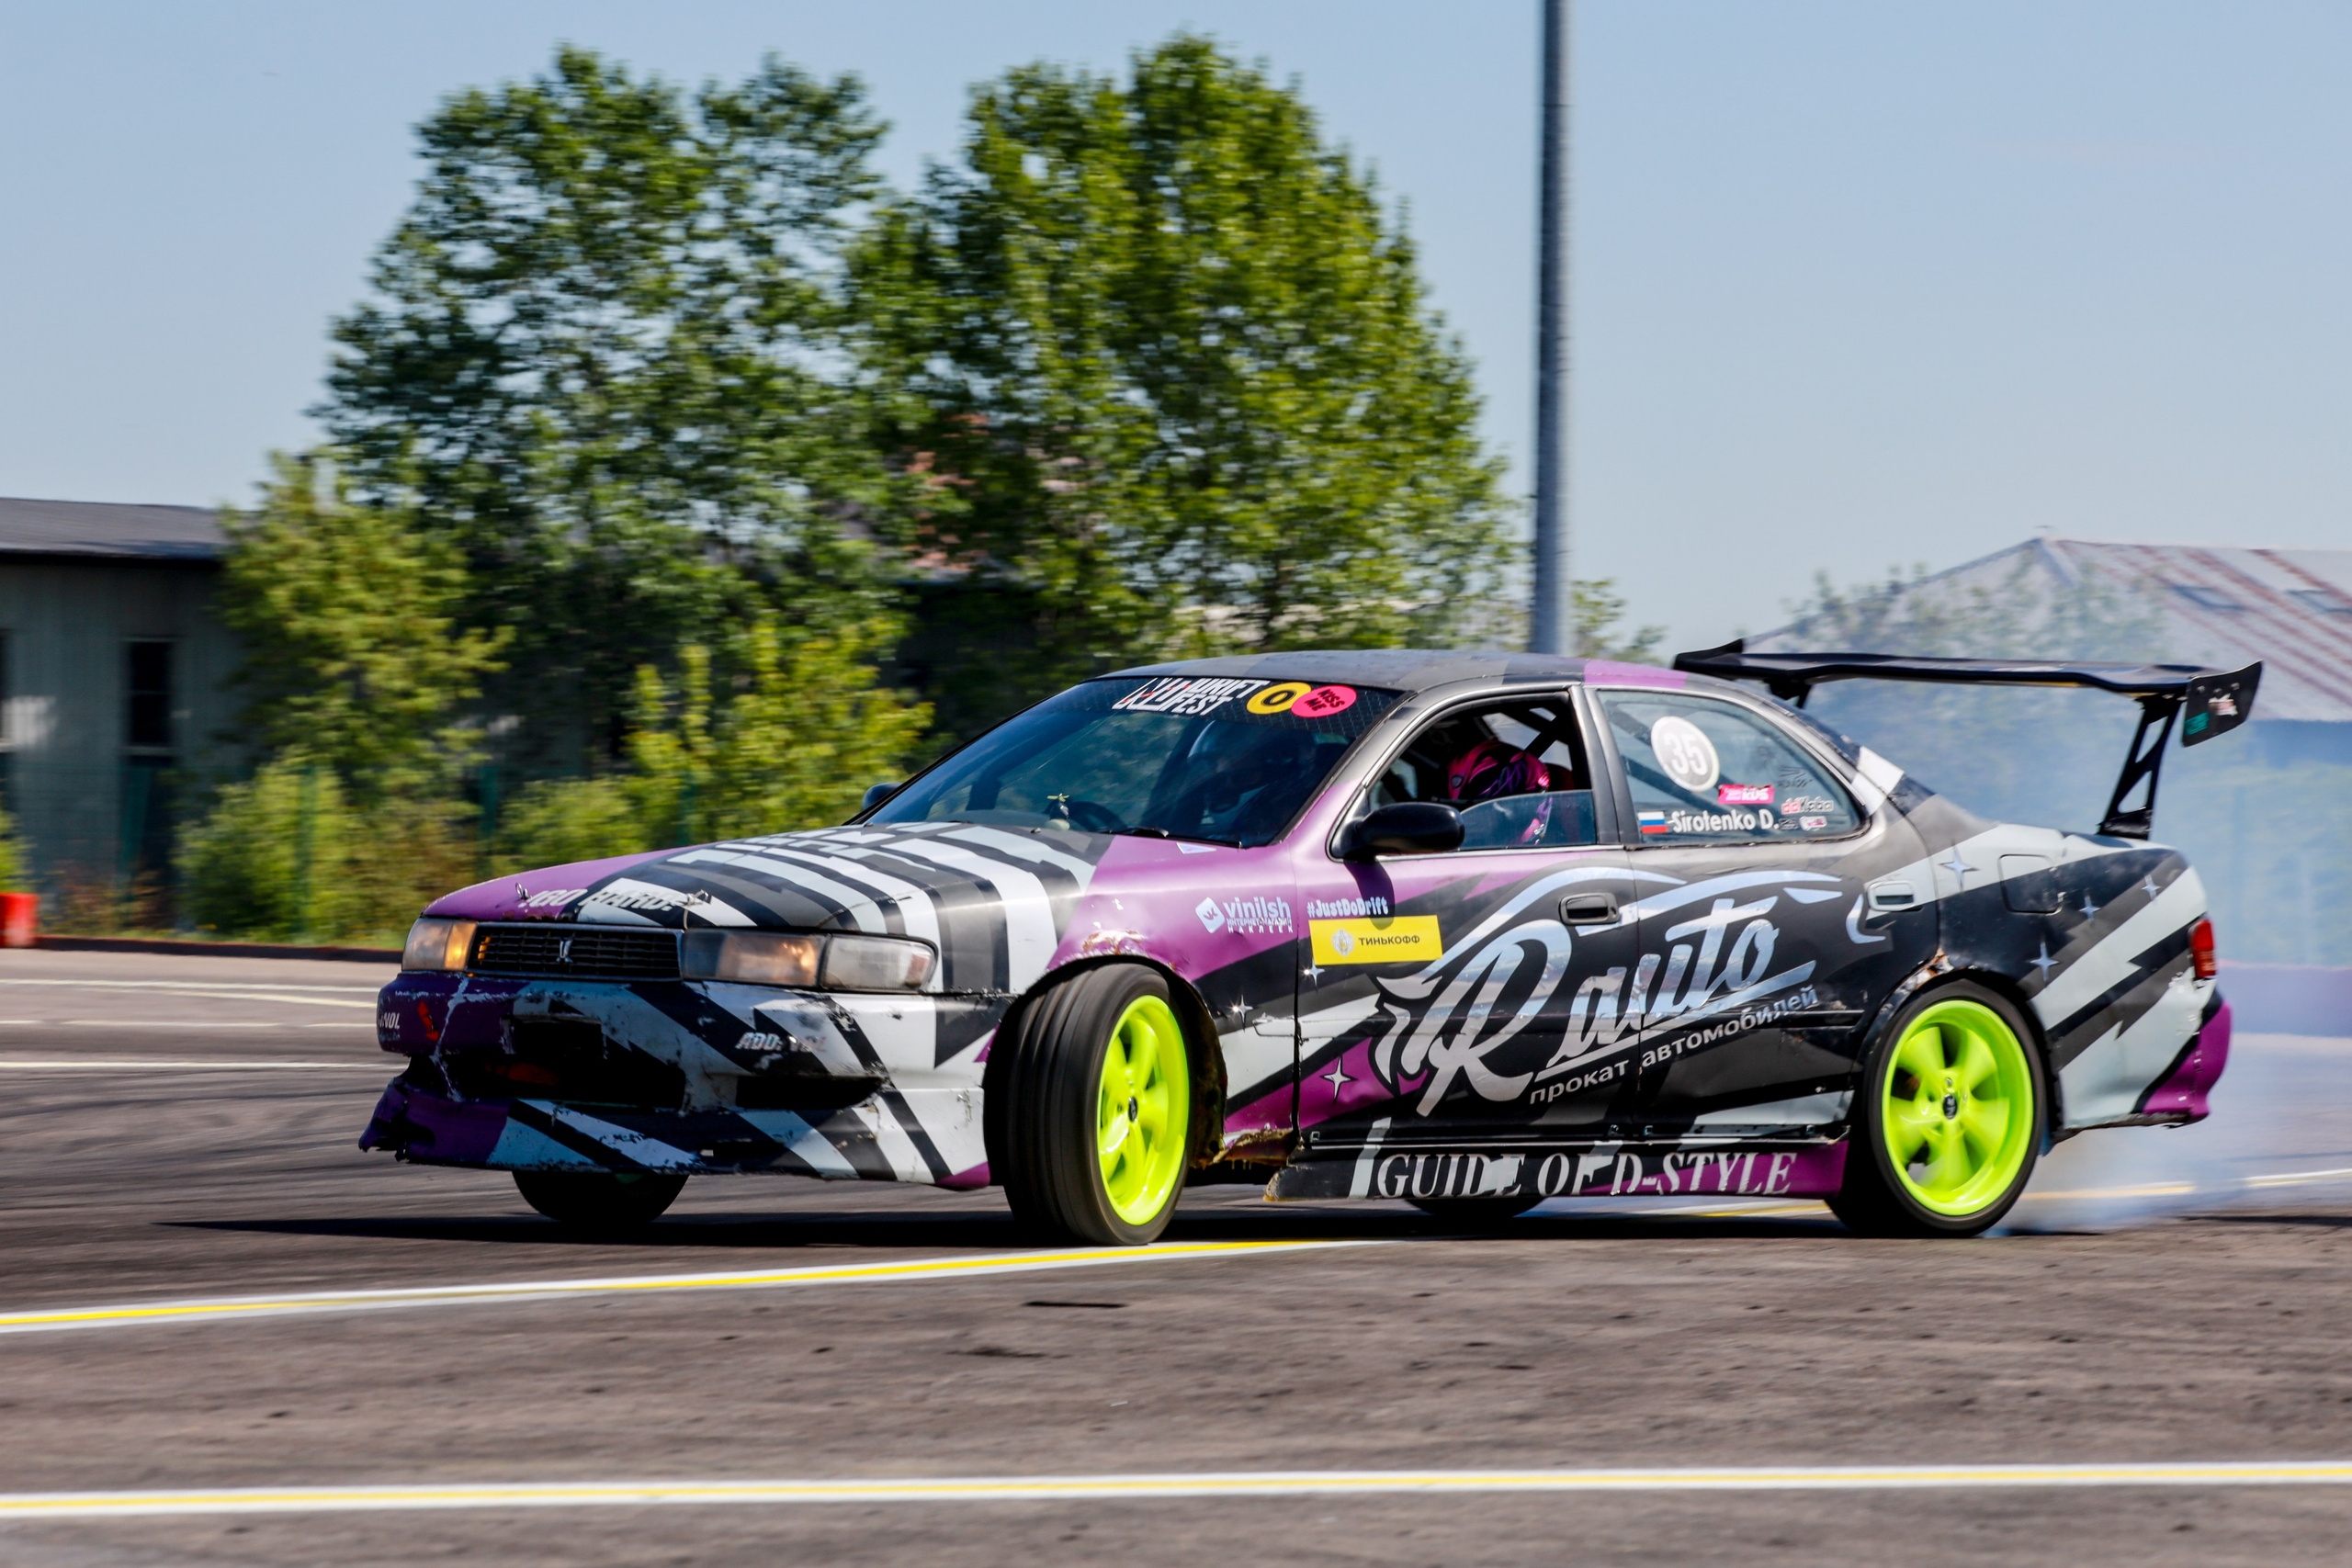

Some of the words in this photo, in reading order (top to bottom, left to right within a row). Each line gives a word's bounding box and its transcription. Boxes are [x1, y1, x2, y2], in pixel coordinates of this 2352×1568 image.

[1159, 693, 1233, 716] FEST
[1304, 697, 1328, 711] ME
[1317, 688, 1346, 708] KISS
[1664, 729, 1709, 777] 35
[1670, 808, 1757, 833] Sirotenko
[1758, 808, 1780, 830] D.
[1223, 897, 1292, 919] vinilsh
[1306, 896, 1389, 919] #JustDoDrift
[1358, 934, 1420, 946] ТИНЬКОФФ
[1529, 1059, 1630, 1104] прокат
[1641, 987, 1819, 1068] автомобилей
[1377, 1151, 1525, 1197] GUIDE
[1537, 1152, 1602, 1197] OF
[1610, 1151, 1798, 1196] D-STYLE
